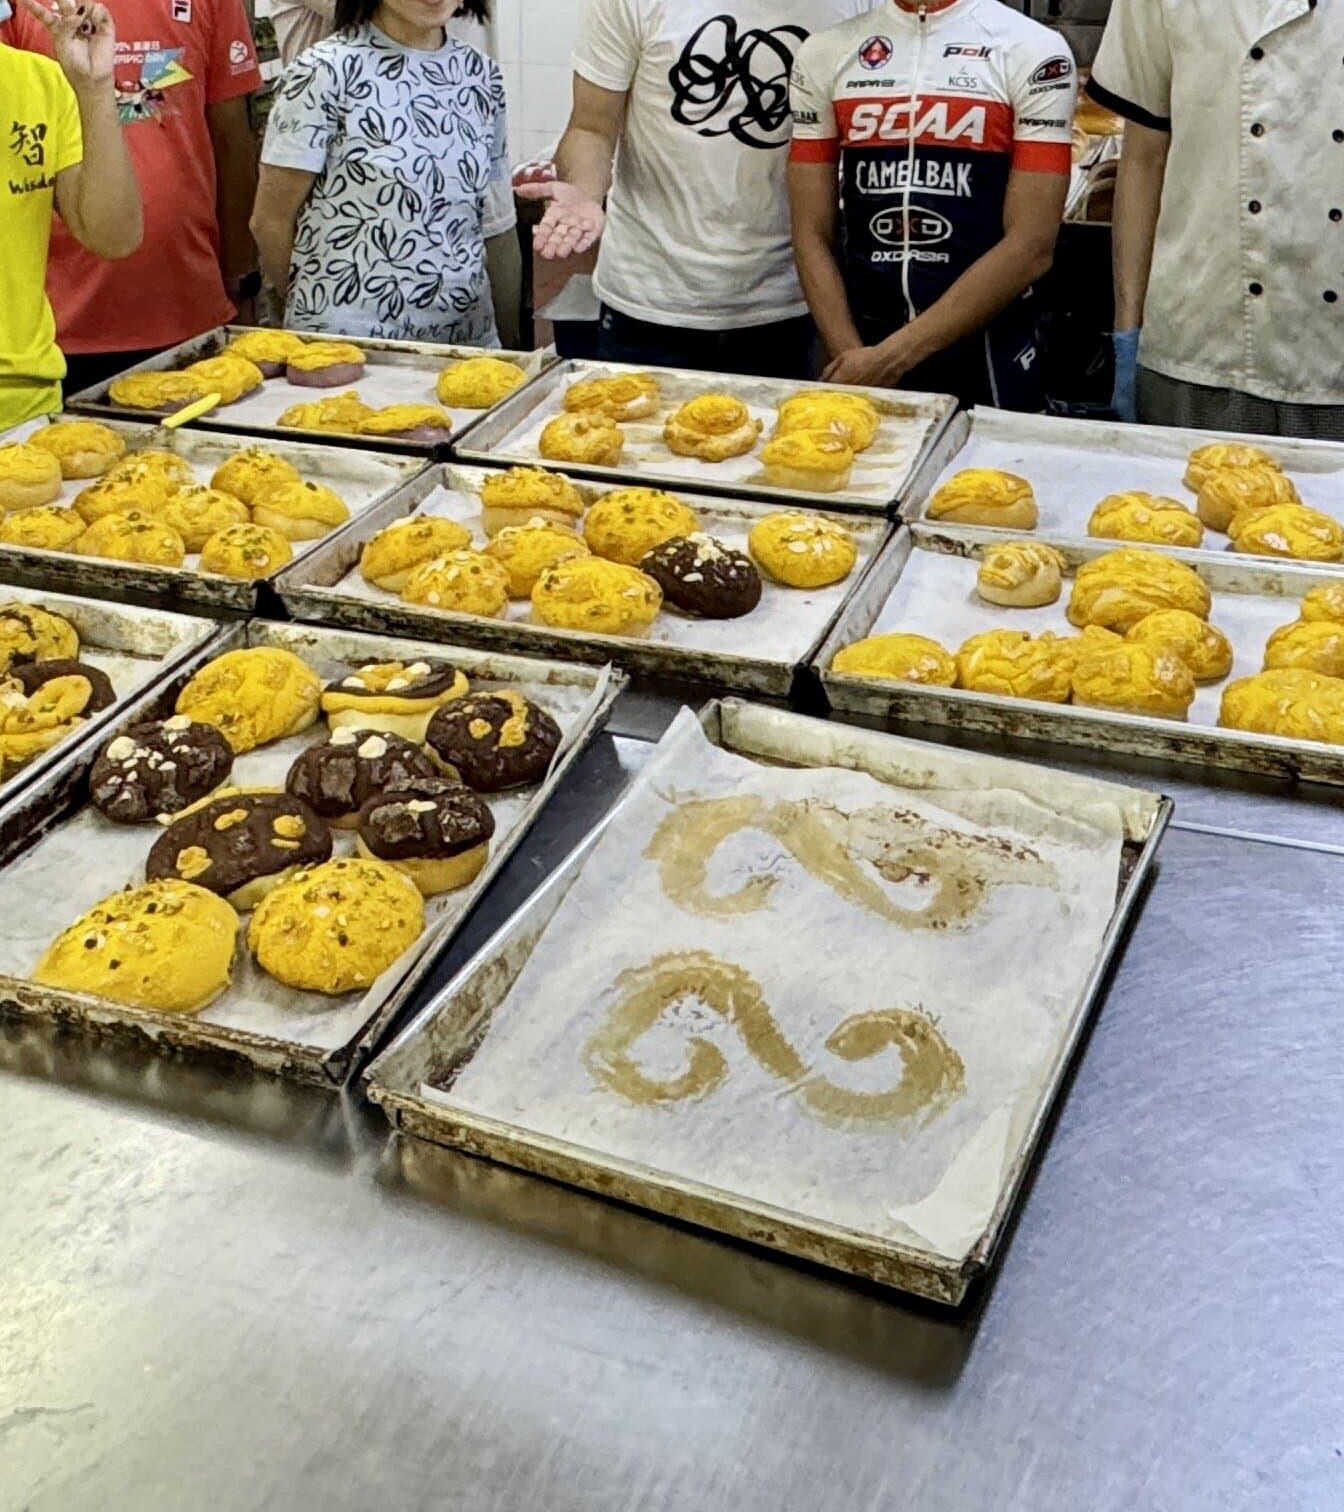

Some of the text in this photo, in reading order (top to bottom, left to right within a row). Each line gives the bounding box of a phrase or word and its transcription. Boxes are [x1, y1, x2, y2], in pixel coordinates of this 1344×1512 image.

[9, 121, 48, 167] 智
[848, 101, 987, 144] SCAA
[856, 158, 972, 197] CAMELBAK
